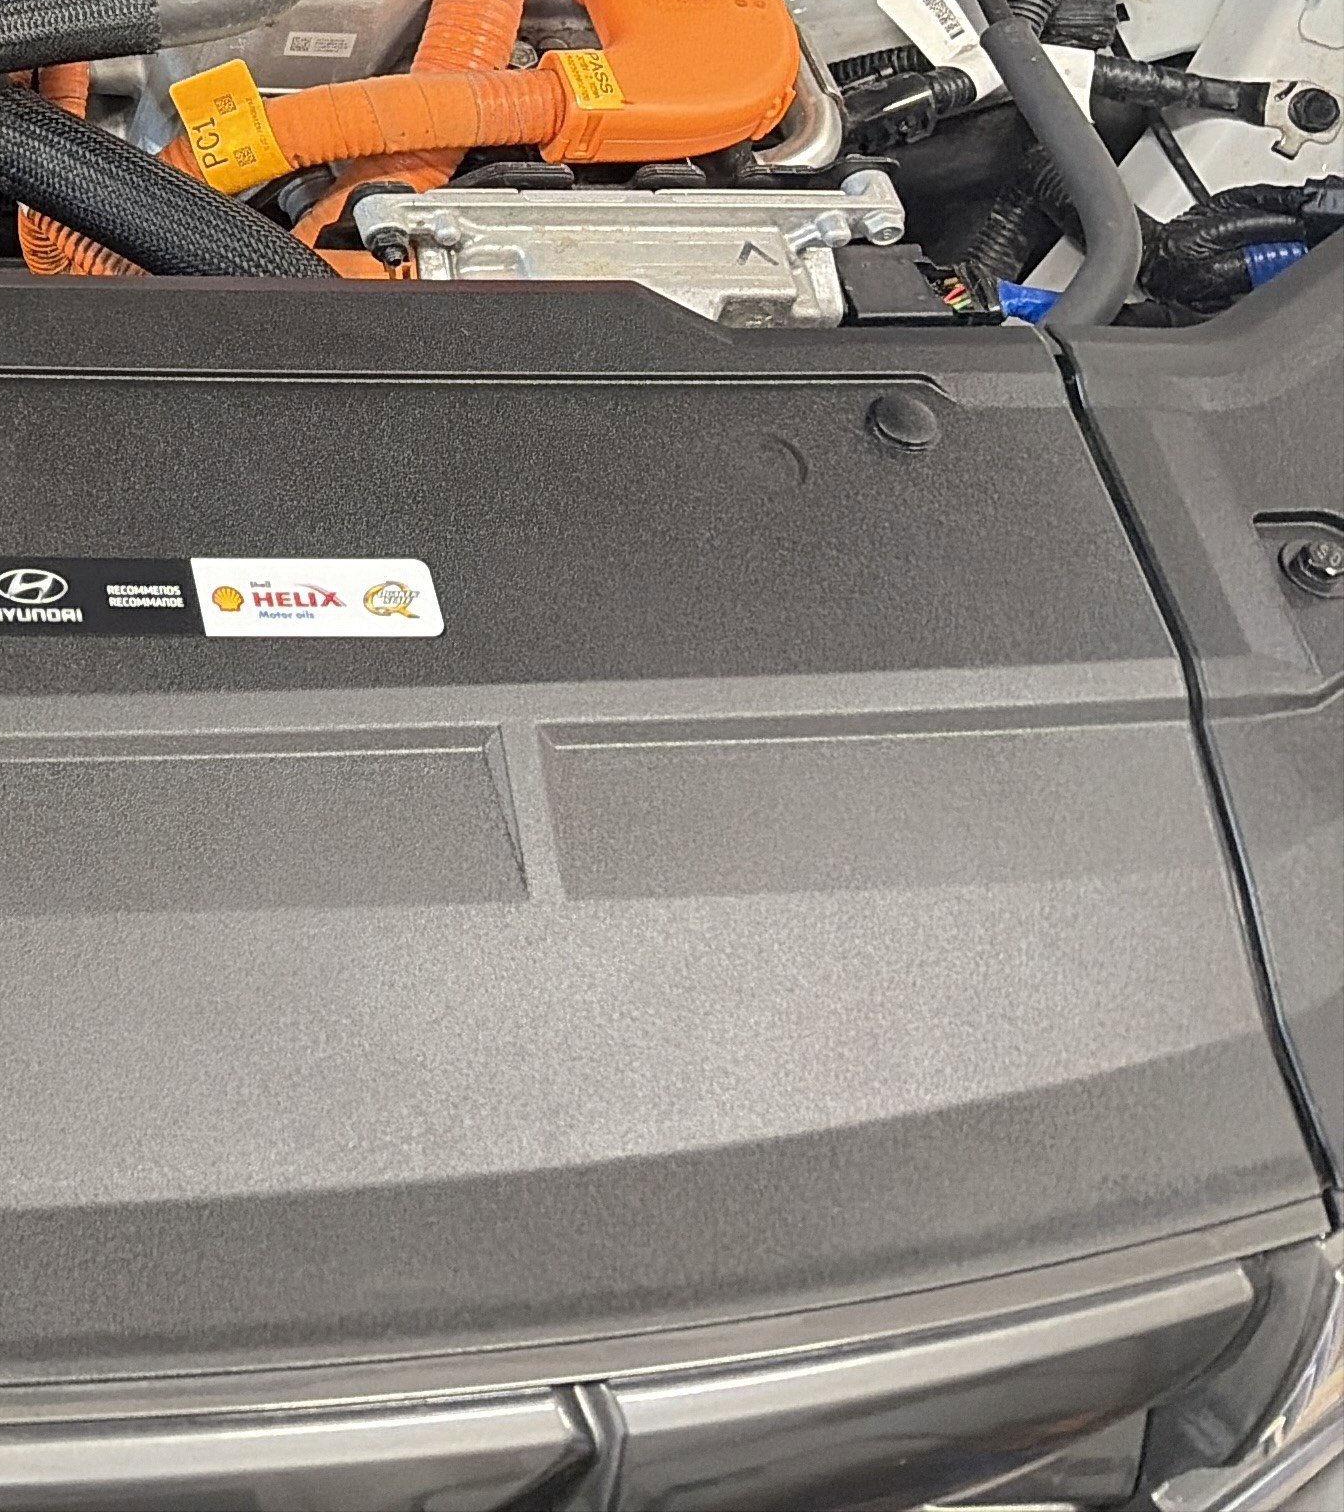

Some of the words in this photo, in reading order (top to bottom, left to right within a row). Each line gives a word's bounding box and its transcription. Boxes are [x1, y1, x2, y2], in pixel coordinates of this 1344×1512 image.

[584, 53, 614, 94] PASS
[192, 117, 229, 169] PC1
[106, 584, 182, 596] RECOMMENDS
[109, 596, 185, 608] RECOMMANDE
[253, 591, 344, 608] HELIX
[259, 610, 293, 619] Motor
[296, 610, 315, 619] oils
